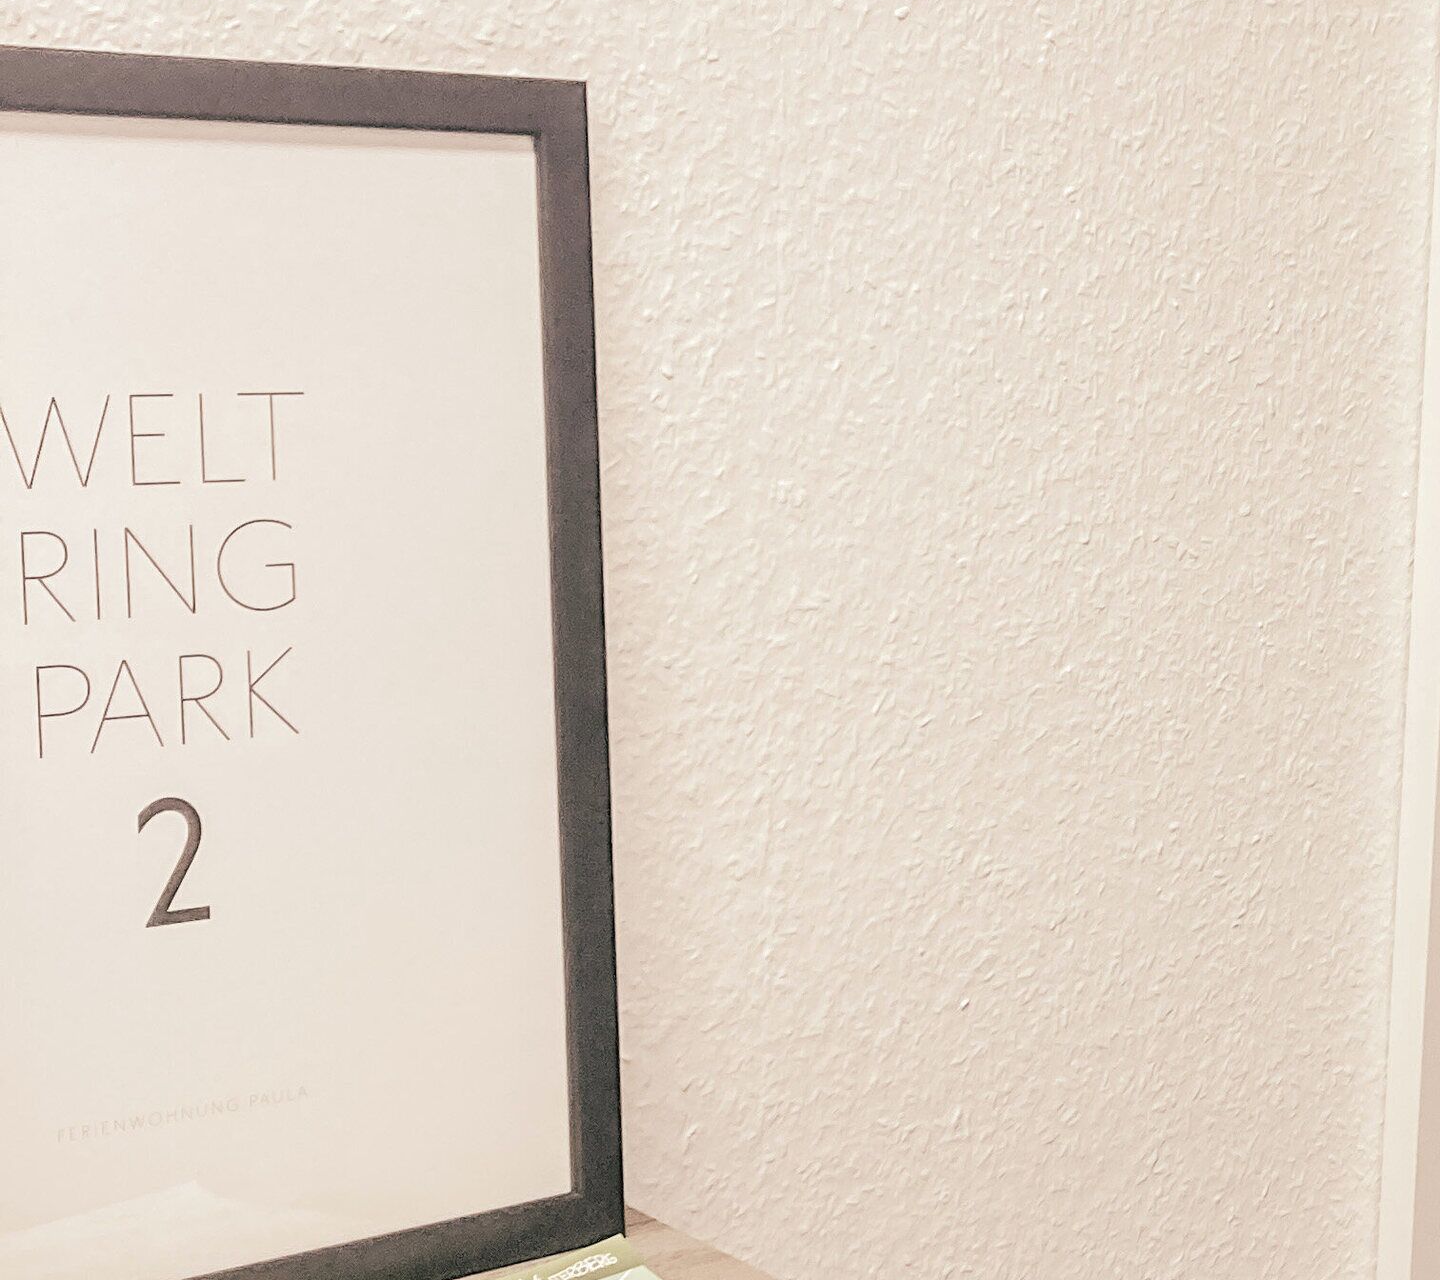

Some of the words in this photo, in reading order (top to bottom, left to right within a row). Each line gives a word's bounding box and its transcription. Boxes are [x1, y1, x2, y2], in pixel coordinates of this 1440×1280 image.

[0, 392, 305, 489] WELT
[21, 519, 297, 625] RING
[36, 646, 300, 759] PARK
[137, 796, 211, 929] 2
[57, 1098, 240, 1143] FERIENWOHNUNG
[249, 1085, 309, 1107] PAULA
